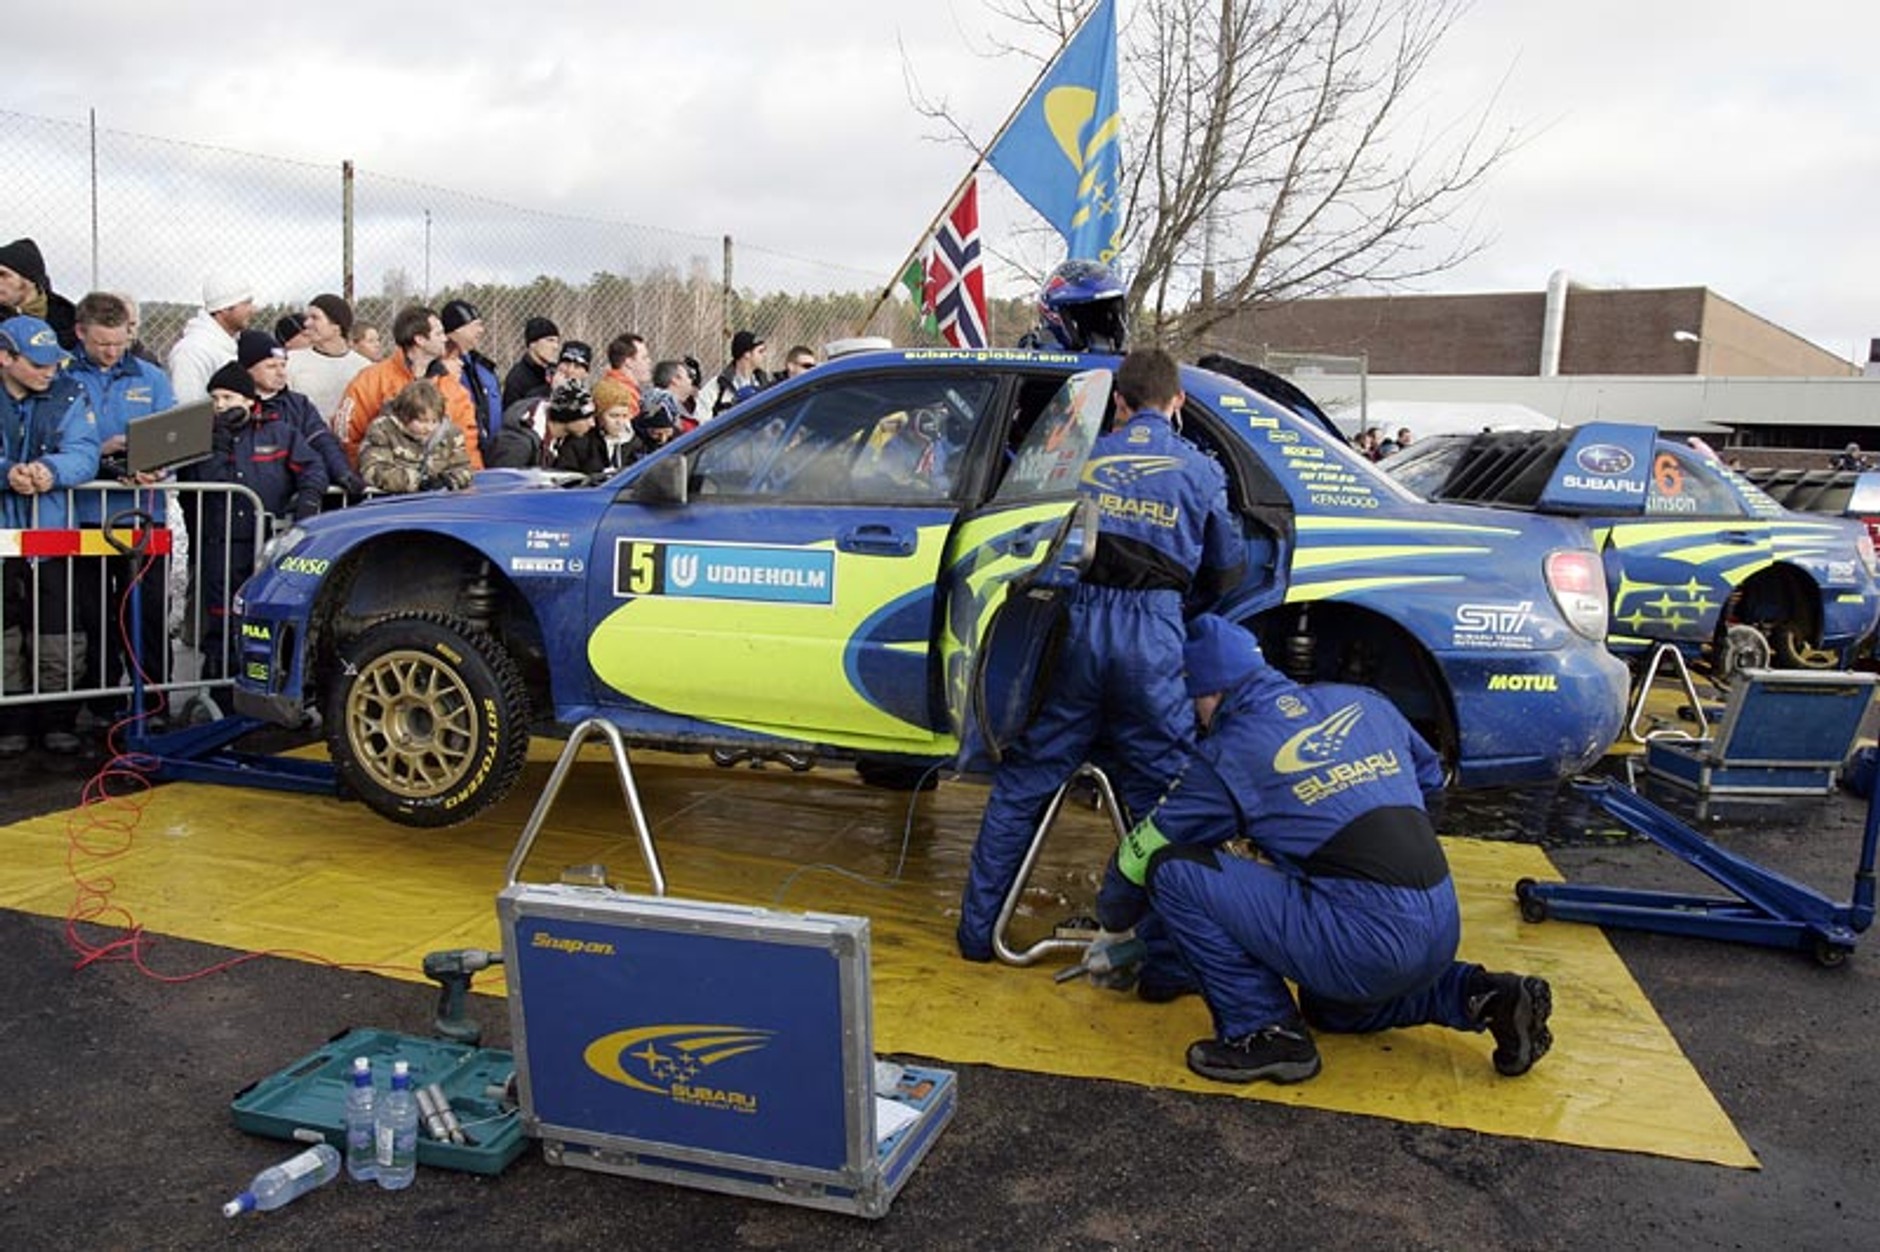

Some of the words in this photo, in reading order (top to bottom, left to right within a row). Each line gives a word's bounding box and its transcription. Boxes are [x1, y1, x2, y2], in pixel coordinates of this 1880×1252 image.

[904, 350, 1079, 363] subaru-global.com
[1563, 474, 1645, 493] SUBARU
[1653, 453, 1685, 496] 6
[1311, 493, 1379, 509] KENWOOD
[279, 556, 331, 576] DENSO
[629, 541, 656, 594] 5
[707, 563, 826, 588] UDDEHOLM
[241, 623, 271, 640] PIAA
[1487, 674, 1559, 692] MOTUL
[1291, 748, 1398, 801] SUBARU
[671, 1082, 757, 1108] SUBARU
